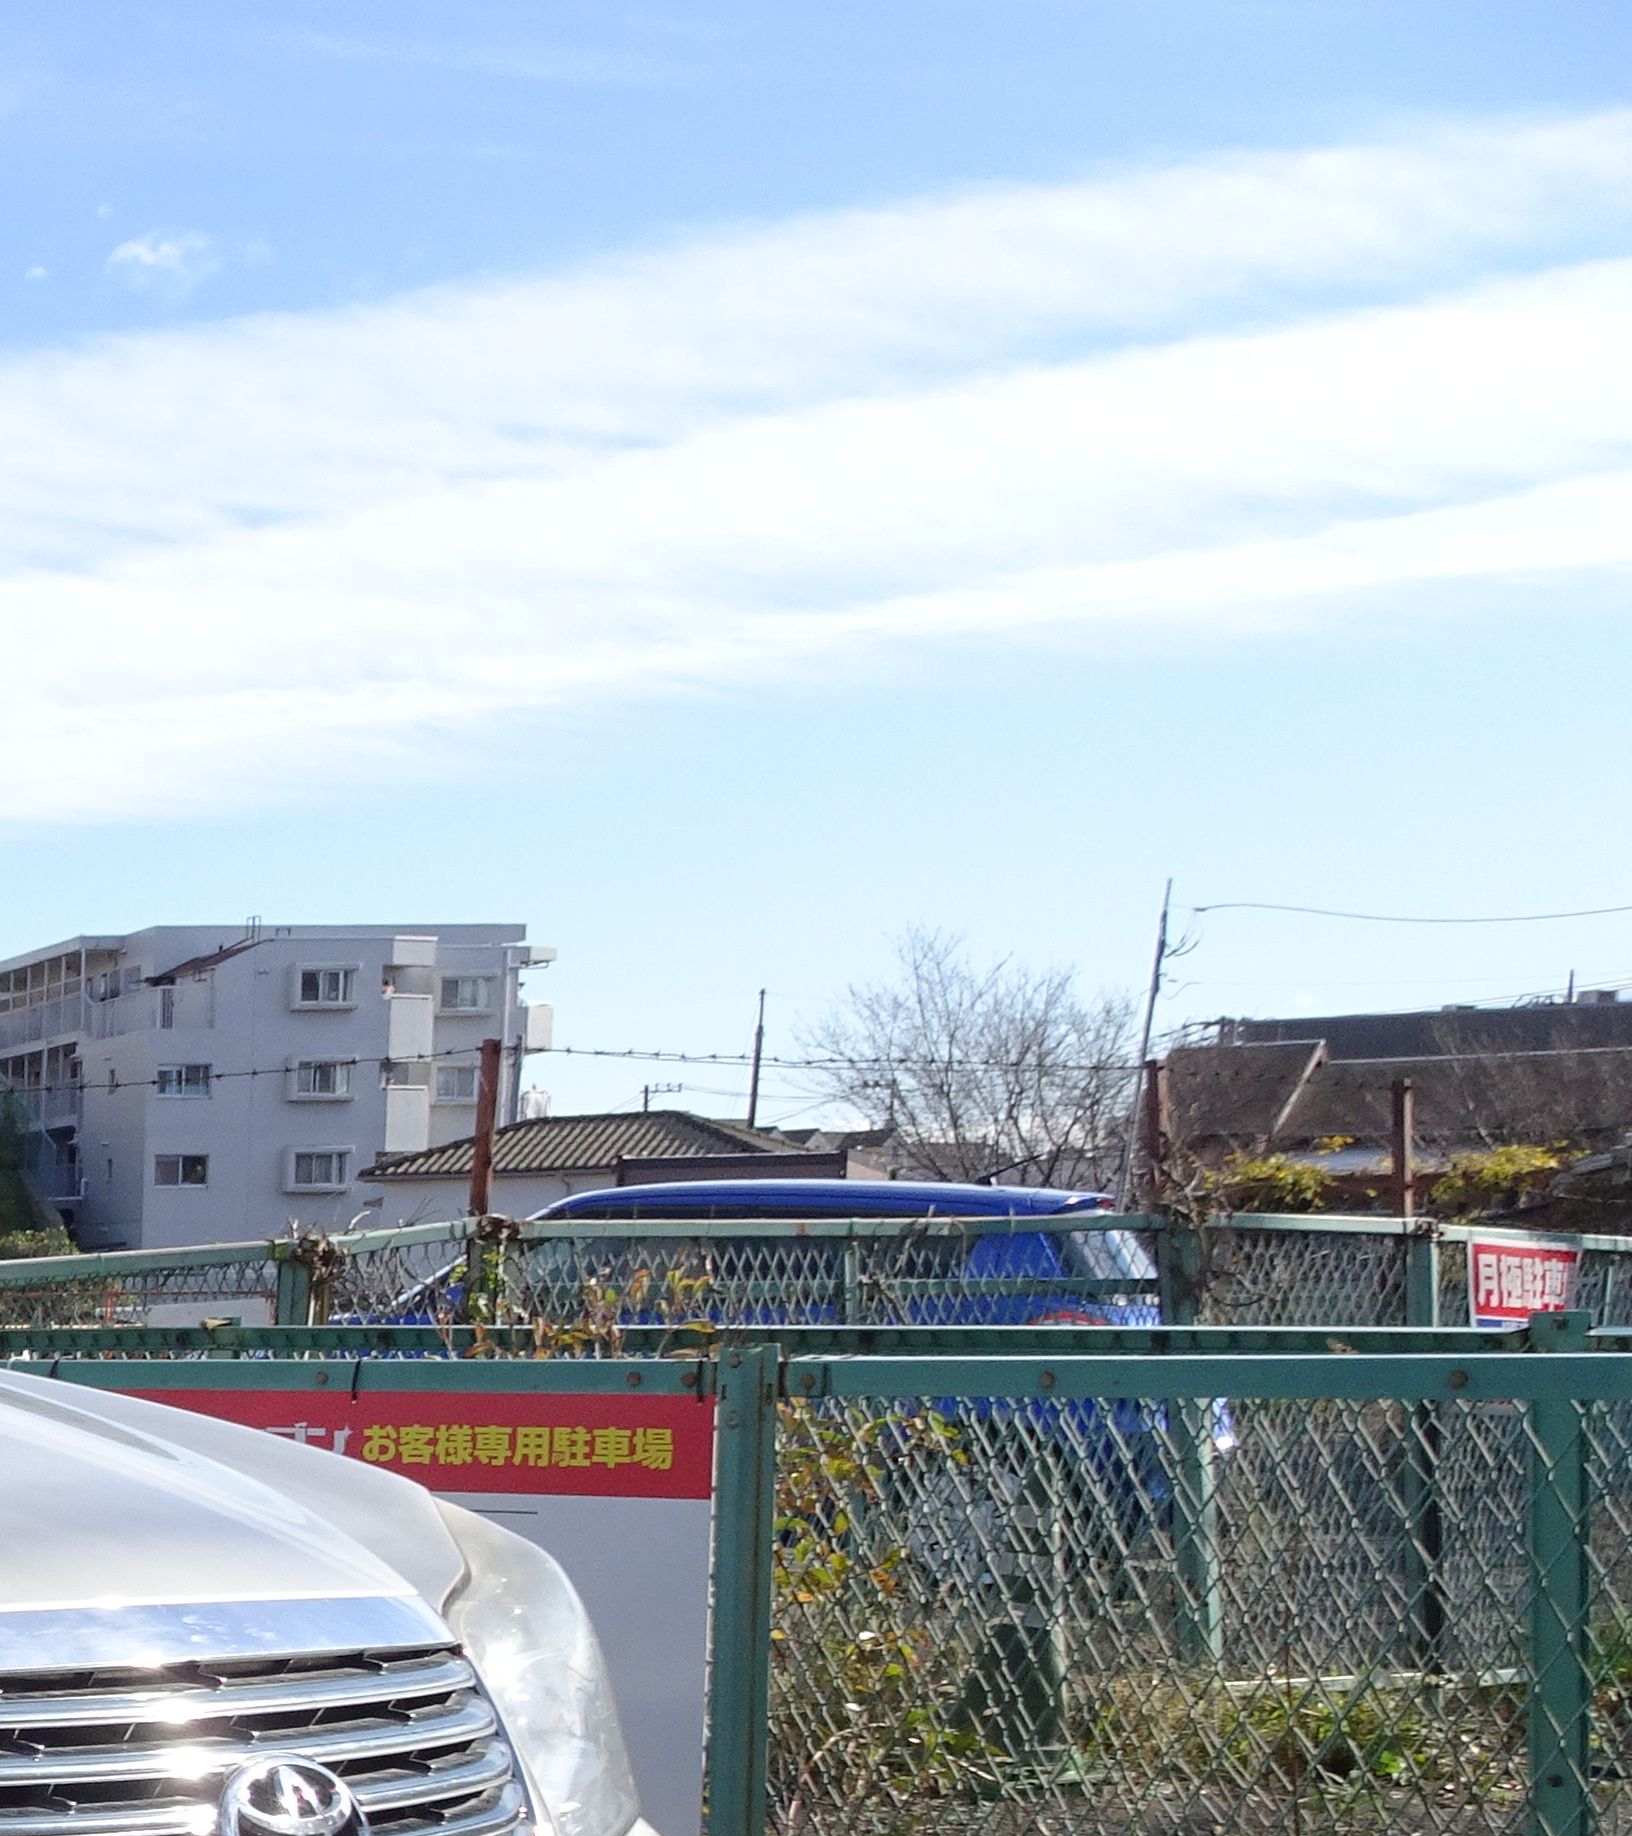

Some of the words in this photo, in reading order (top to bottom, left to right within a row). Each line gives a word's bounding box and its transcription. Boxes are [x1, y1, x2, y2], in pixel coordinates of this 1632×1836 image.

[1477, 1252, 1569, 1312] 月極駐車
[362, 1424, 674, 1470] お客様専用駐車場
